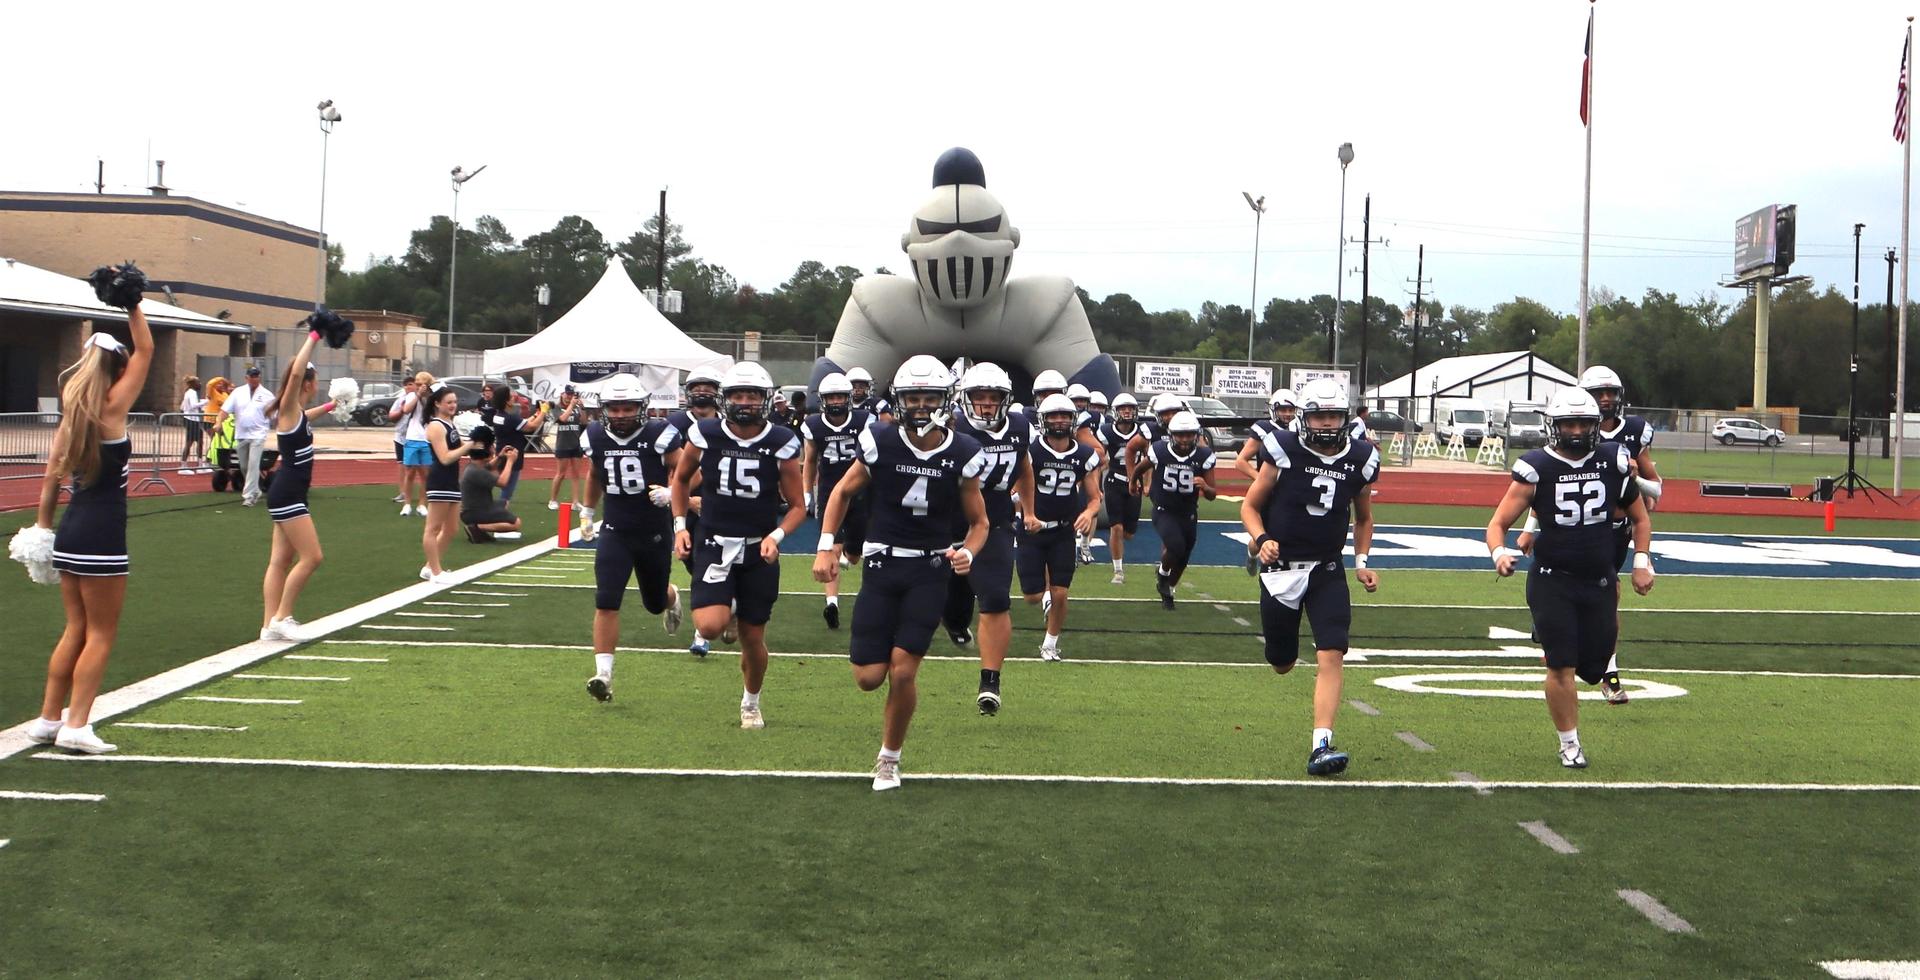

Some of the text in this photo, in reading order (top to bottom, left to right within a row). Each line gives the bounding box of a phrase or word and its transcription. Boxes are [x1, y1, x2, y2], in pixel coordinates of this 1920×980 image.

[1141, 376, 1190, 387] STATE CHAMPS
[1218, 380, 1267, 390] STATE CHAMPS
[720, 449, 762, 459] CRUSADERS
[823, 438, 857, 464] 45
[604, 456, 645, 495] 18
[716, 456, 761, 499] 15
[895, 464, 943, 477] CRUSADERS
[978, 450, 1018, 491] 77
[1043, 461, 1075, 470] CRUSADERS
[1304, 466, 1347, 480] CRUSADERS
[1558, 472, 1601, 482] CRUSADERS
[1037, 468, 1077, 496] 32
[1162, 466, 1194, 493] 59
[901, 475, 929, 516] 4
[1306, 475, 1337, 517] 3
[1554, 480, 1608, 526] 52
